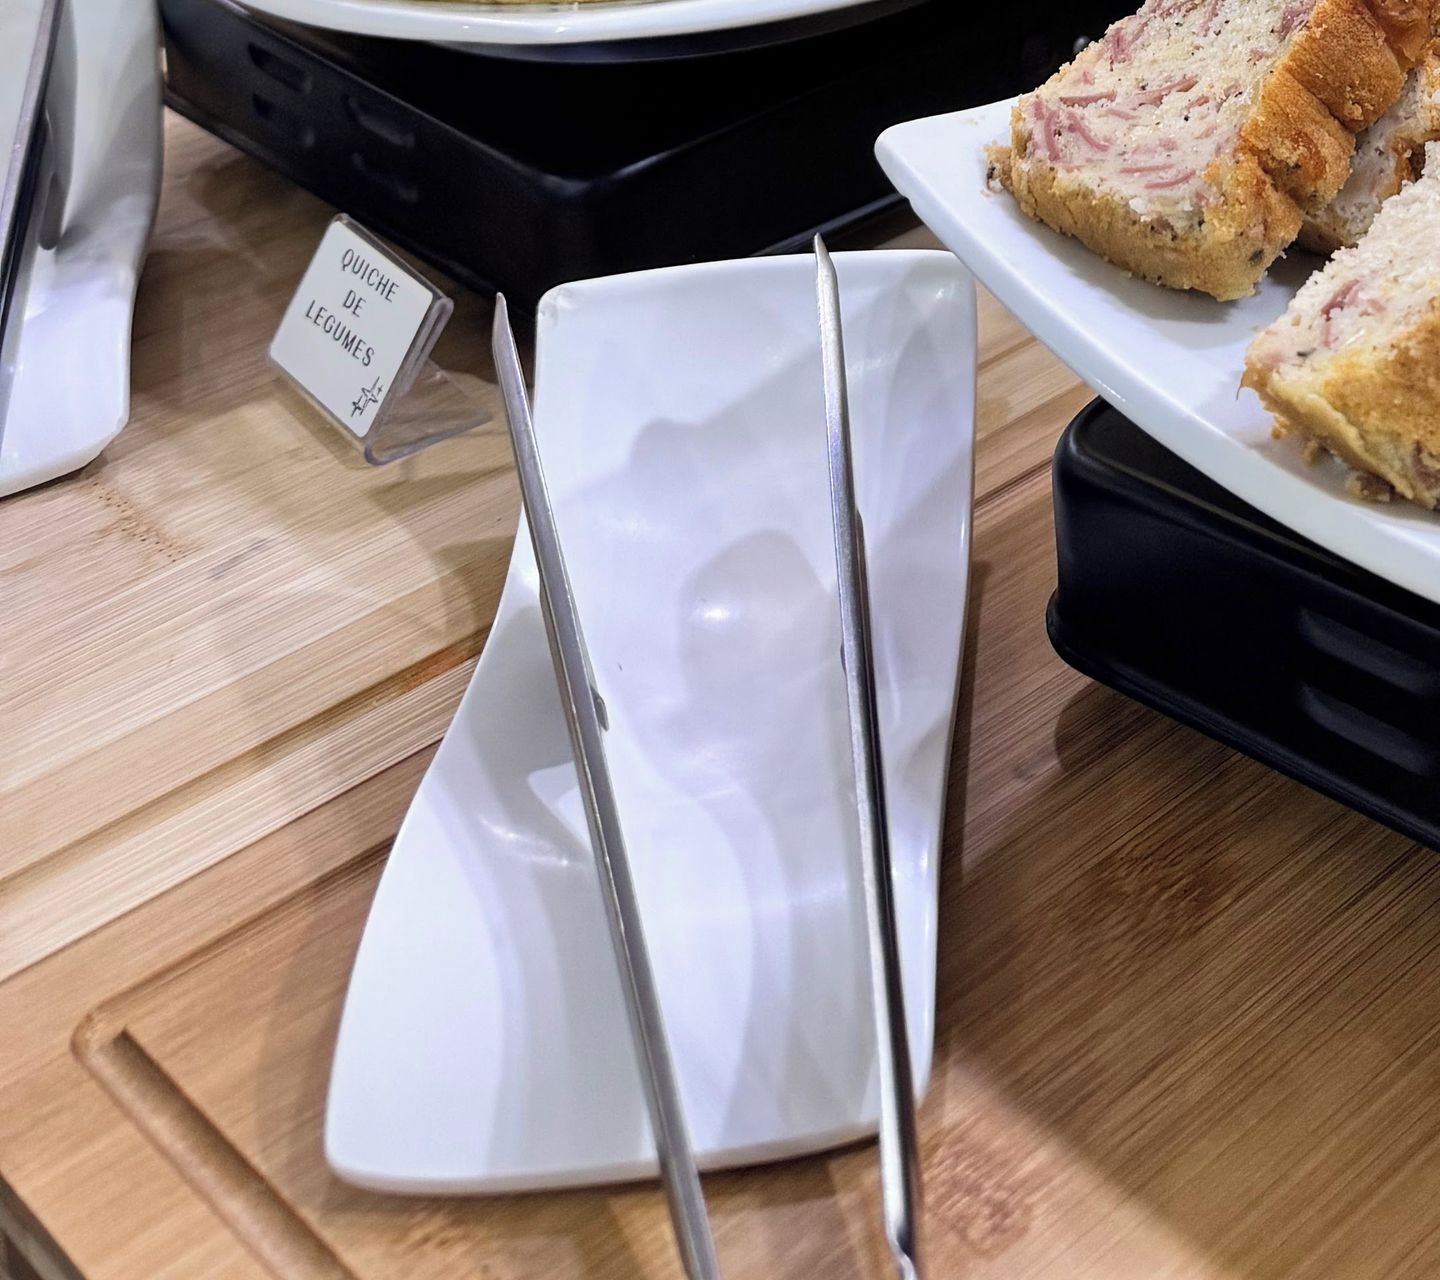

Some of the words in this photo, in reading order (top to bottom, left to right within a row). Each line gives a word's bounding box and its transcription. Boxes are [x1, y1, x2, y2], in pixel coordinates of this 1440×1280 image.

[340, 248, 399, 303] QUICHE
[342, 289, 367, 318] DE
[304, 299, 375, 367] LEGUMES
